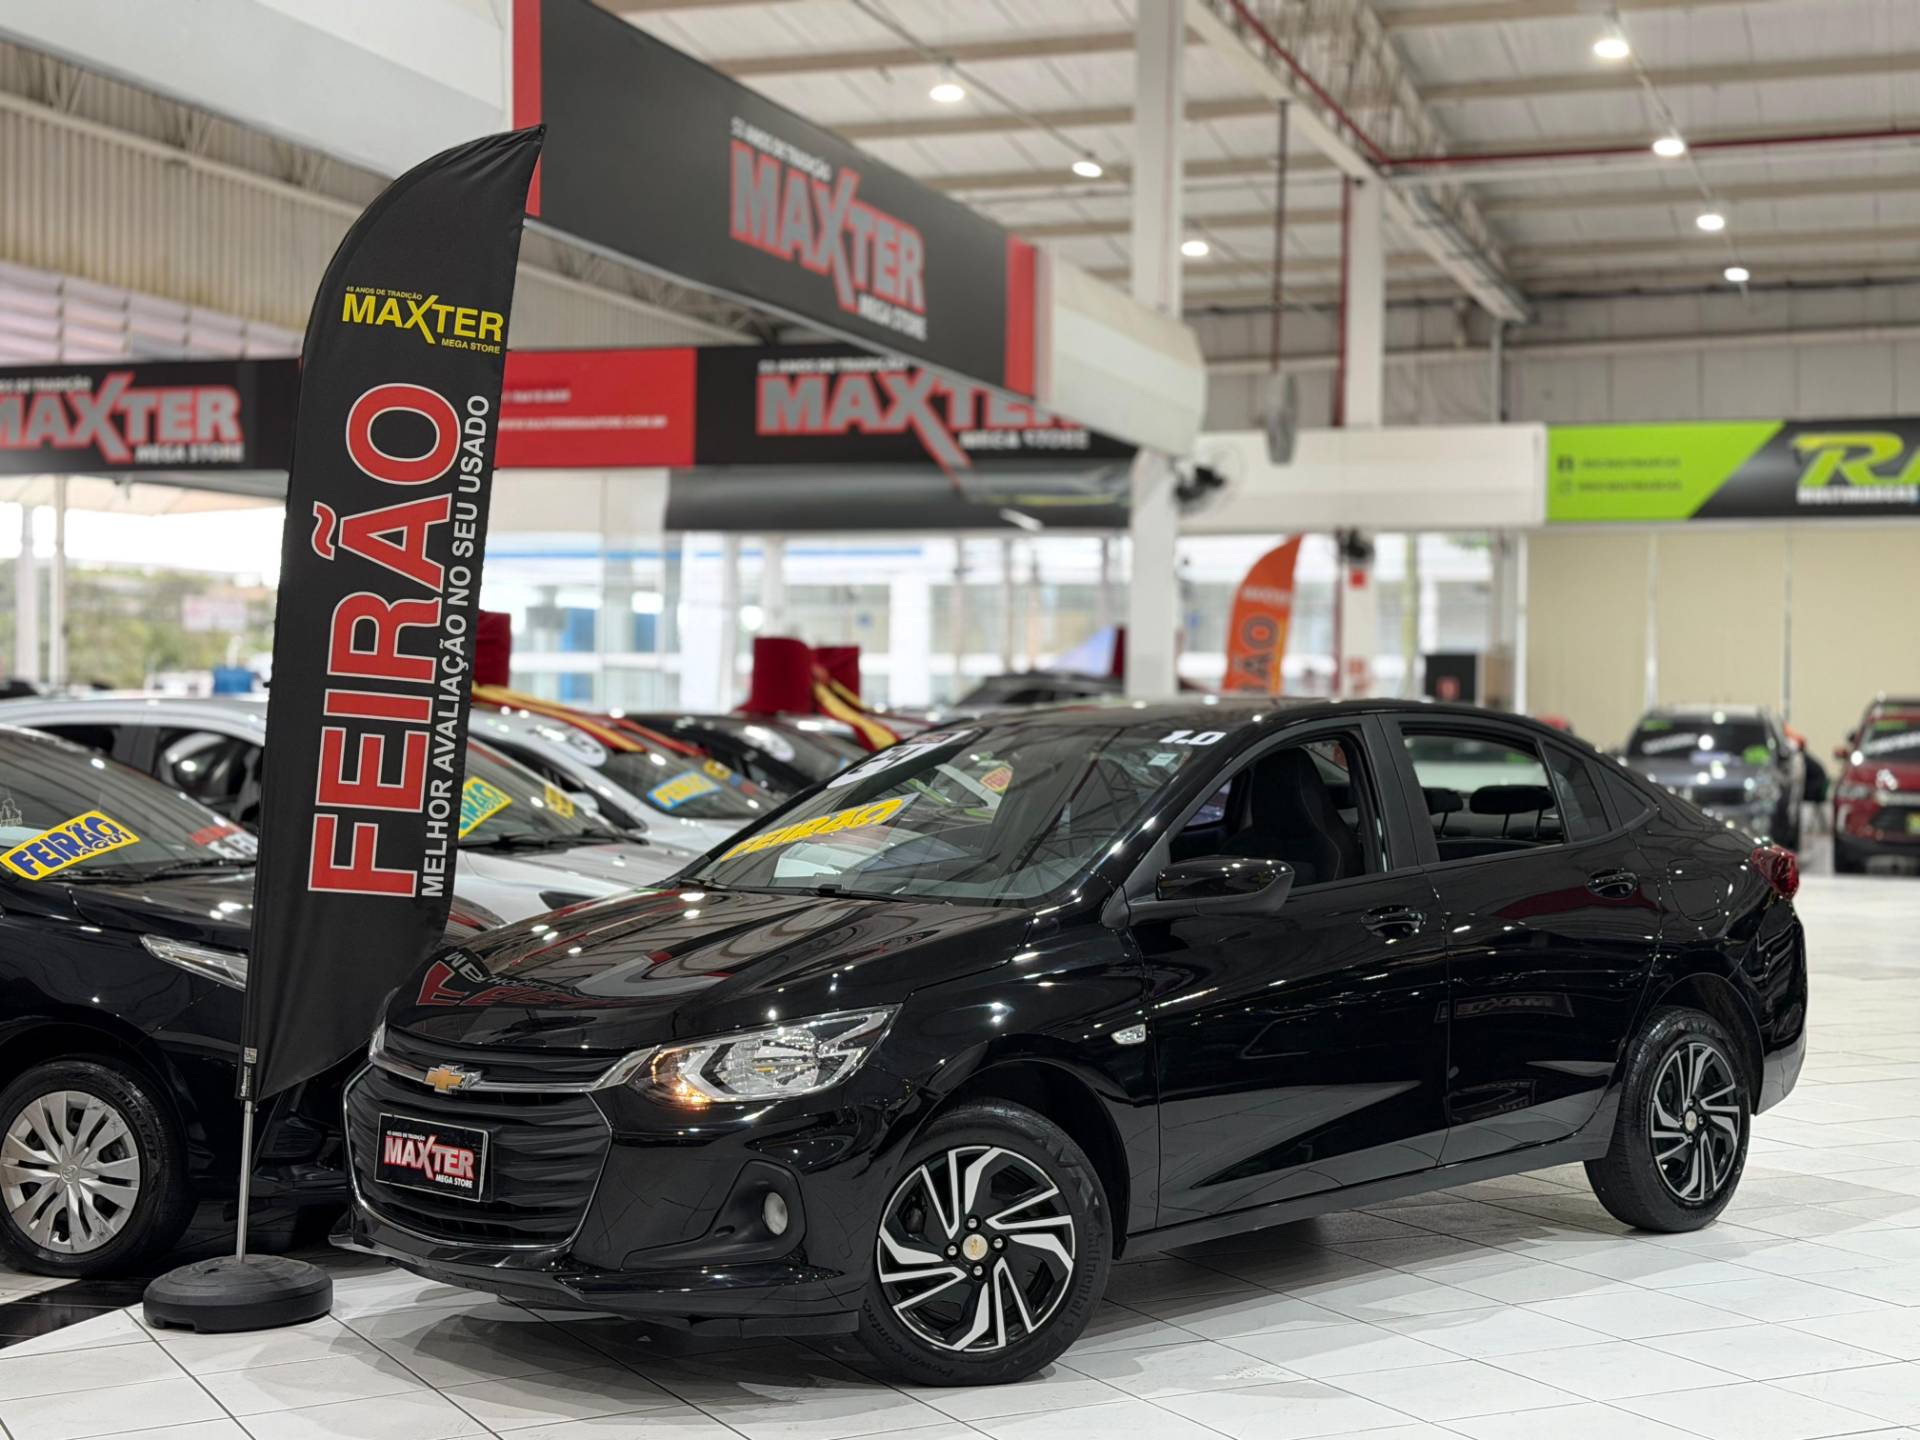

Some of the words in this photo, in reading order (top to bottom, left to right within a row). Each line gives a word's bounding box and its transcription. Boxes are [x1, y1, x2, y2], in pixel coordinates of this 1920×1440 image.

[730, 137, 927, 315] MAXTER
[355, 286, 375, 295] ANOS
[341, 294, 504, 345] MAXTER
[441, 338, 469, 350] MEGA
[470, 341, 500, 354] STORE
[458, 395, 490, 493] USADO
[452, 501, 479, 558] SEU
[447, 565, 472, 606] NO
[307, 382, 461, 898] FEIRÃO
[432, 615, 469, 773] AVALIAÇÃO
[1158, 729, 1227, 745] 1.0
[9, 816, 121, 876] FEIRÃO
[421, 779, 453, 897] MELHOR
[384, 1135, 475, 1181] MAXTER
[435, 1174, 454, 1184] MEGA
[454, 1178, 473, 1189] STORE
